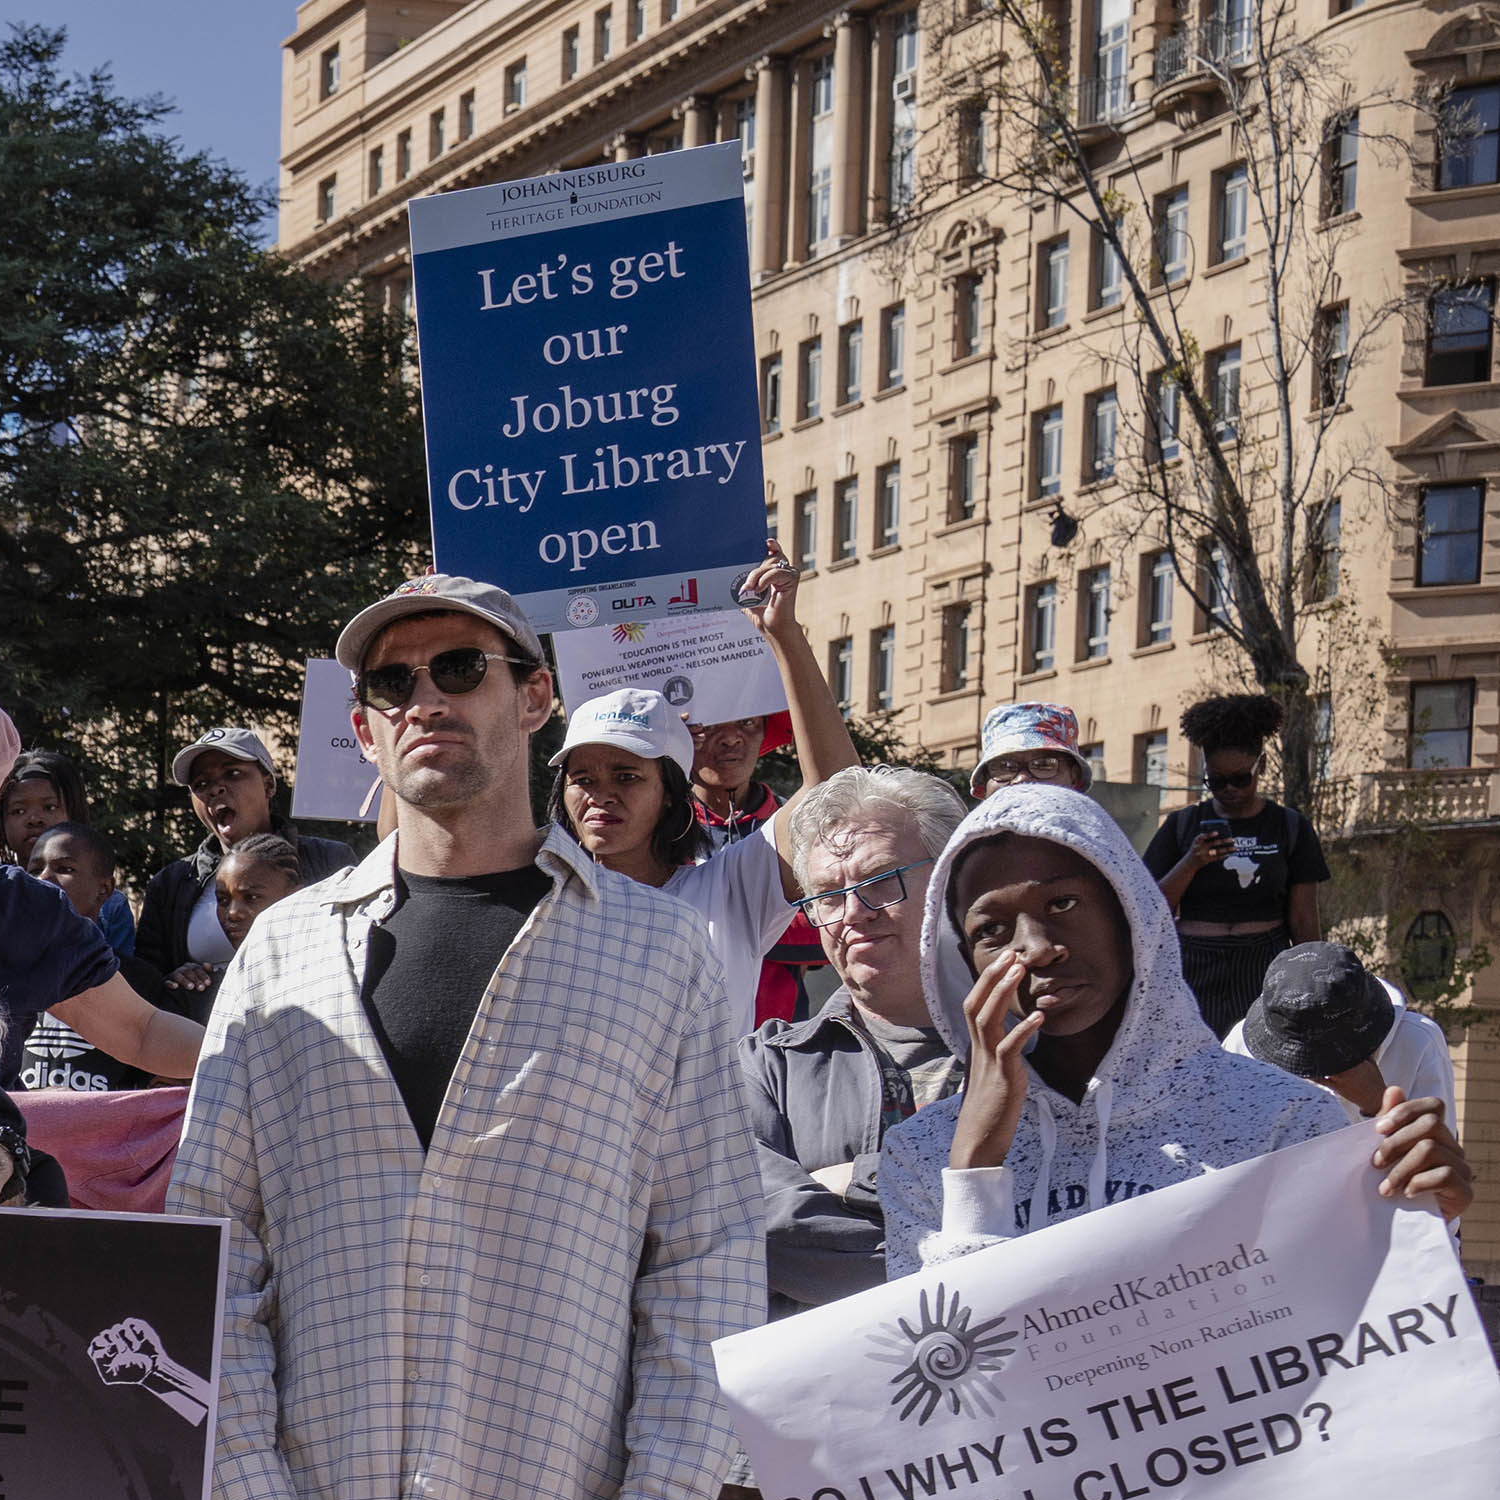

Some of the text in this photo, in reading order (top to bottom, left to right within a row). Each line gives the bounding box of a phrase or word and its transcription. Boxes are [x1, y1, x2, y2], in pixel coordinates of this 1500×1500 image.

[500, 163, 646, 205] JOHANNESBURG
[490, 190, 662, 231] HERITAGE FOUNDATION
[609, 241, 686, 299] get
[542, 323, 628, 366] our
[502, 383, 680, 438] Joburg
[447, 440, 747, 513] City Library
[538, 518, 661, 571] open
[612, 595, 656, 610] OUTA
[582, 665, 627, 680] POWERFUL
[627, 655, 665, 671] WEAPON
[666, 649, 696, 663] WHICH
[697, 646, 717, 657] YOU
[717, 641, 736, 652] CAN
[737, 638, 754, 648] USE
[671, 641, 680, 650] IS
[682, 637, 697, 648] THE
[699, 631, 724, 644] MOST
[588, 677, 622, 691] CHANGE
[623, 673, 641, 684] THE
[685, 656, 719, 670] NELSON
[720, 647, 764, 663] MANDELA
[331, 737, 357, 749] COJ
[18, 1061, 109, 1091] didas
[1022, 1243, 1270, 1340] AhmedKathrada
[1045, 1303, 1295, 1392] Deepening Non-Racialism
[1023, 1416, 1079, 1466] IS
[1087, 1375, 1206, 1444] THE
[1216, 1294, 1461, 1403] LIBRARY
